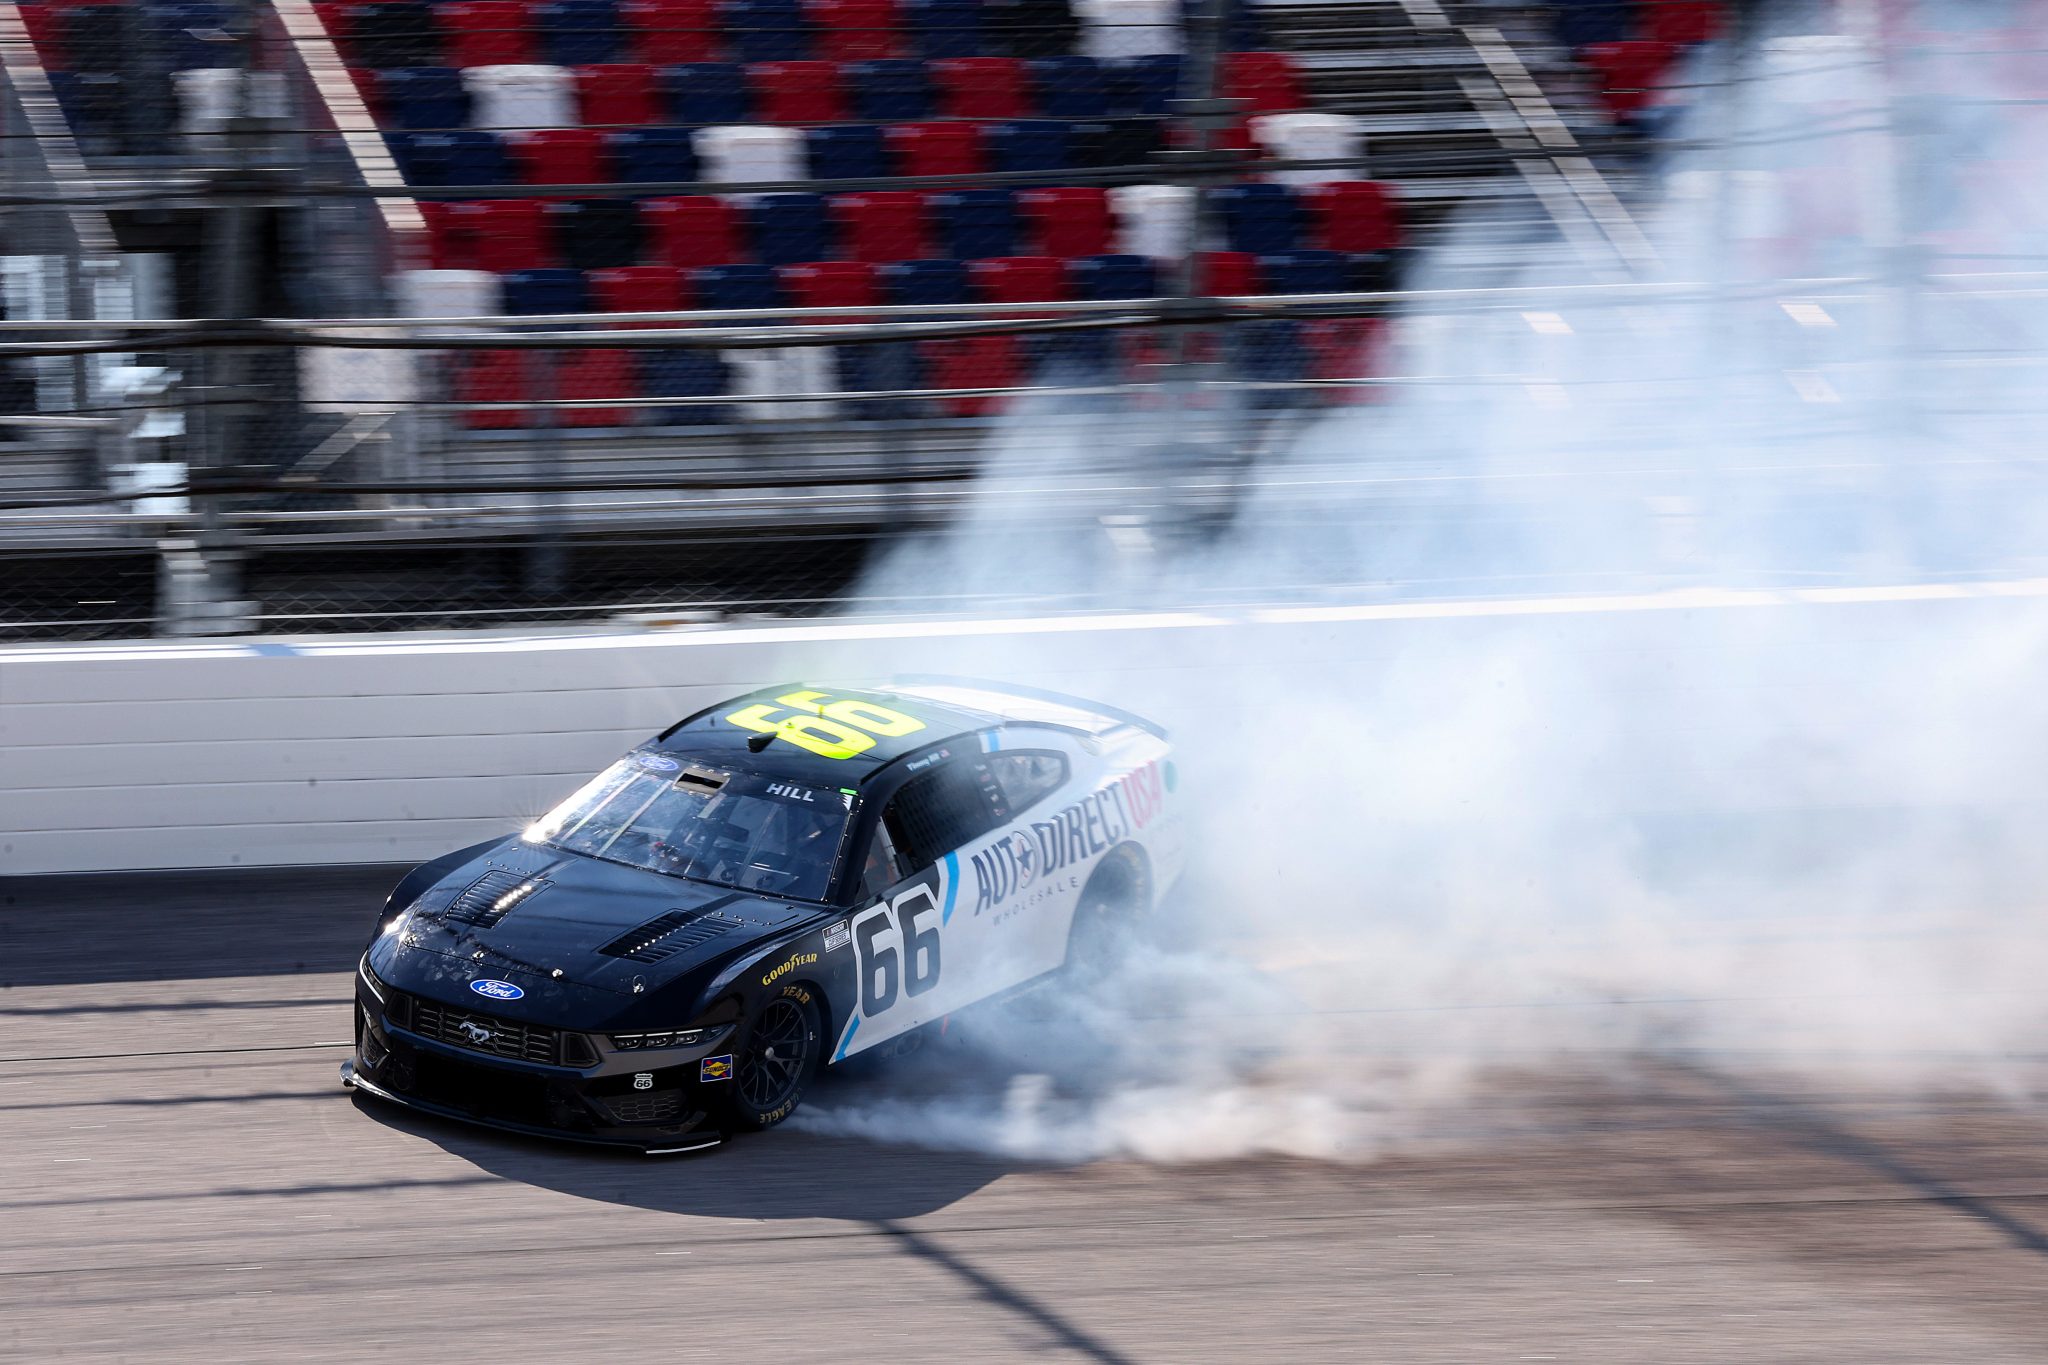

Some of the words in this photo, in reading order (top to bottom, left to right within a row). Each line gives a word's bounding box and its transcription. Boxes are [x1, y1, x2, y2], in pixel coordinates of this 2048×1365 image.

[725, 690, 927, 760] 66
[766, 783, 814, 802] HILL
[853, 886, 943, 1019] 66
[762, 953, 817, 985] GOODYEAR
[479, 982, 515, 997] Ford
[636, 1079, 651, 1088] 66
